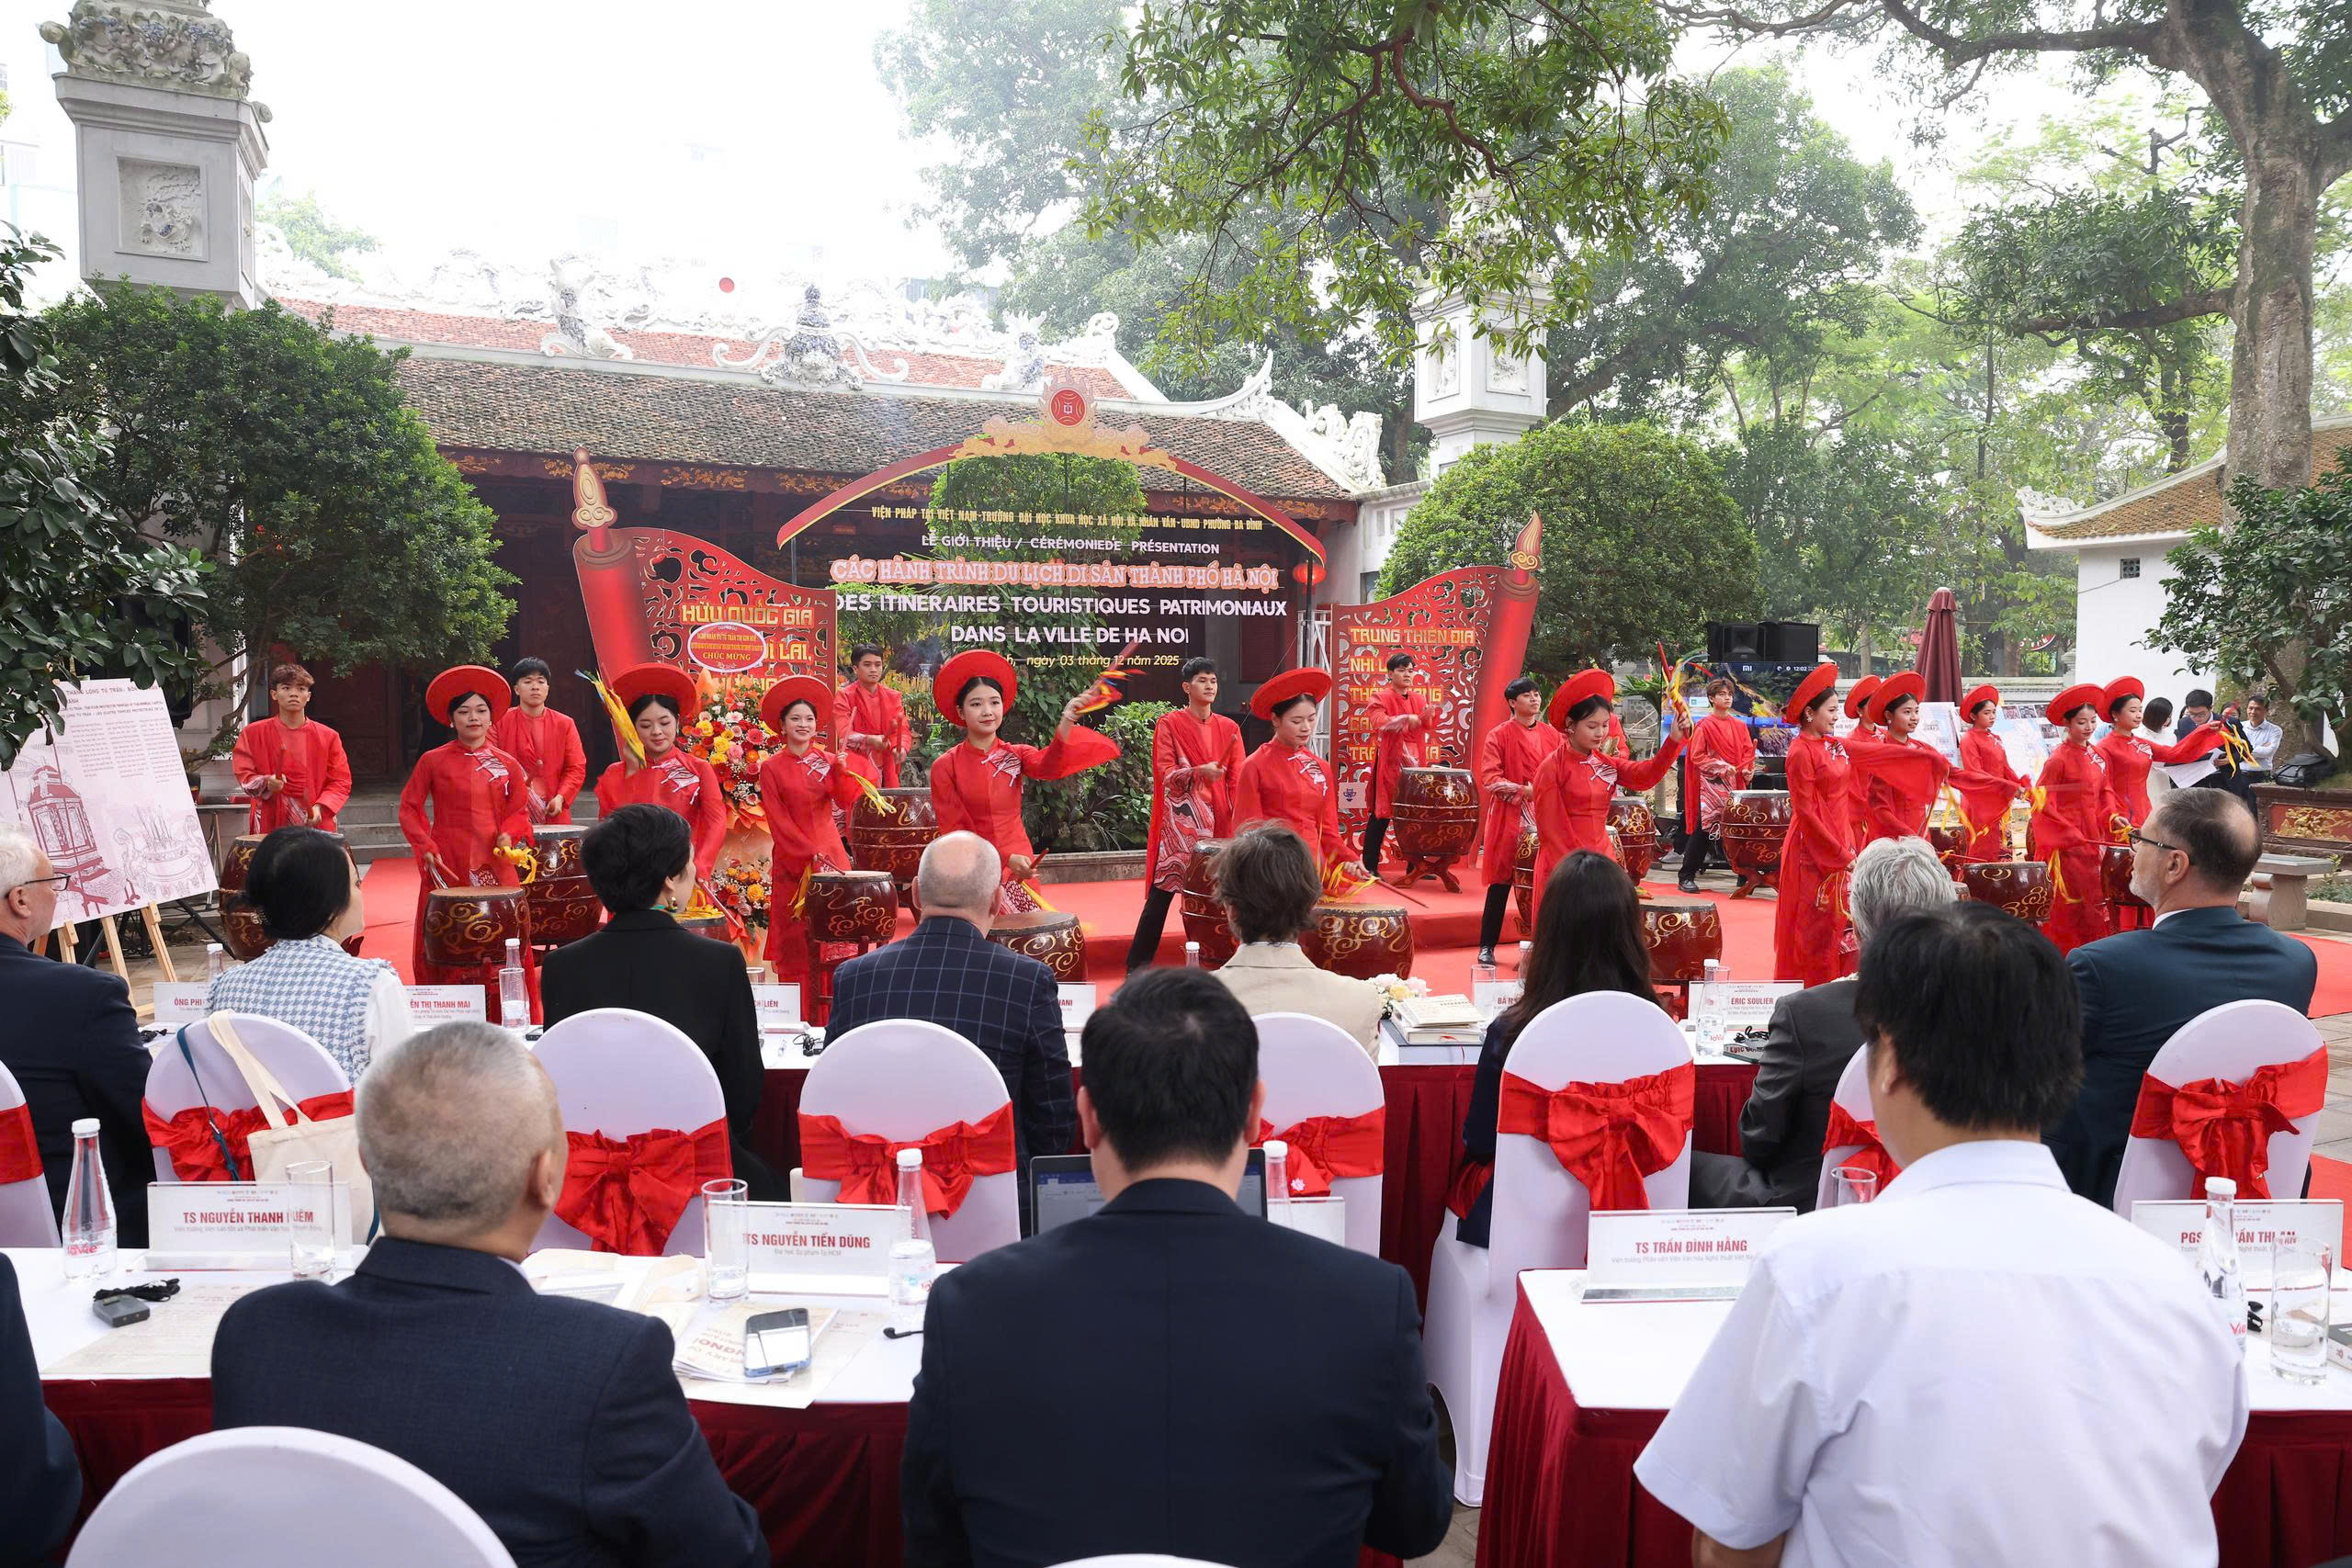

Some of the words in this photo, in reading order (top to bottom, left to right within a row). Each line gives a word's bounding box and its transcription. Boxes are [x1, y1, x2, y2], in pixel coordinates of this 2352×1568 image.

[872, 505, 891, 520] VIỆN
[895, 506, 917, 519] PHÁP
[937, 507, 955, 523] VIỆT
[1019, 511, 1033, 525] ĐẠI
[1035, 513, 1052, 526] HỌC
[1056, 513, 1075, 525] KHOA
[1079, 514, 1093, 527] HỌC
[1139, 514, 1159, 528] NHÂN
[1204, 516, 1231, 530] PHƯỜNG
[1234, 519, 1244, 530] BA
[1246, 517, 1262, 531] ĐÌNH
[941, 533, 969, 547] GIỚI
[973, 536, 1011, 551] THIỆU
[1131, 538, 1220, 554] PRÉSENTATION
[832, 557, 876, 581] CÁC
[879, 556, 932, 582] HÀNH
[935, 557, 990, 582] TRÌNH
[992, 562, 1018, 582] DU
[1020, 562, 1064, 587] LỊCH
[1067, 565, 1087, 585] DI
[1090, 561, 1126, 586] SẢN
[1130, 561, 1184, 586] THÀNH
[1187, 560, 1219, 586] PHỐ
[1222, 564, 1243, 587] HÀ
[1247, 564, 1278, 592] NỘI
[682, 601, 722, 623] HỮU
[783, 608, 813, 626] GIA
[836, 593, 872, 611] DES
[880, 595, 1001, 613] ITINERAIRES
[1012, 596, 1150, 615] TOURISTIQUES
[1160, 599, 1287, 616] PATRIMONIAUX
[951, 626, 1006, 642] DANS
[1096, 627, 1120, 643] DE
[1125, 627, 1152, 643] HA
[1157, 627, 1190, 644] NOI
[1351, 627, 1401, 643] TRUNG
[1403, 626, 1447, 644] THIÊN
[1451, 629, 1474, 649] ĐỊA
[702, 650, 725, 660] CHÚC
[1025, 655, 1056, 668] ngày
[1060, 655, 1074, 666] 03
[1078, 654, 1110, 668] tháng
[1114, 656, 1125, 666] 12
[1126, 655, 1151, 666] năm
[1153, 655, 1180, 666] 2025
[1350, 658, 1375, 672] NHI
[174, 997, 188, 1006] ÔNG
[434, 1000, 456, 1009] THANH
[183, 1212, 197, 1224] TS
[200, 1208, 244, 1224] NGUYỄN
[248, 1212, 284, 1224] THANH
[763, 1231, 807, 1247] NGUYỄN
[811, 1232, 835, 1247] TIẾN
[840, 1234, 870, 1248] DŨNG
[1636, 1242, 1648, 1254] TS
[1686, 1238, 1713, 1253] ĐÌNH
[1717, 1235, 1747, 1252] HẰNG
